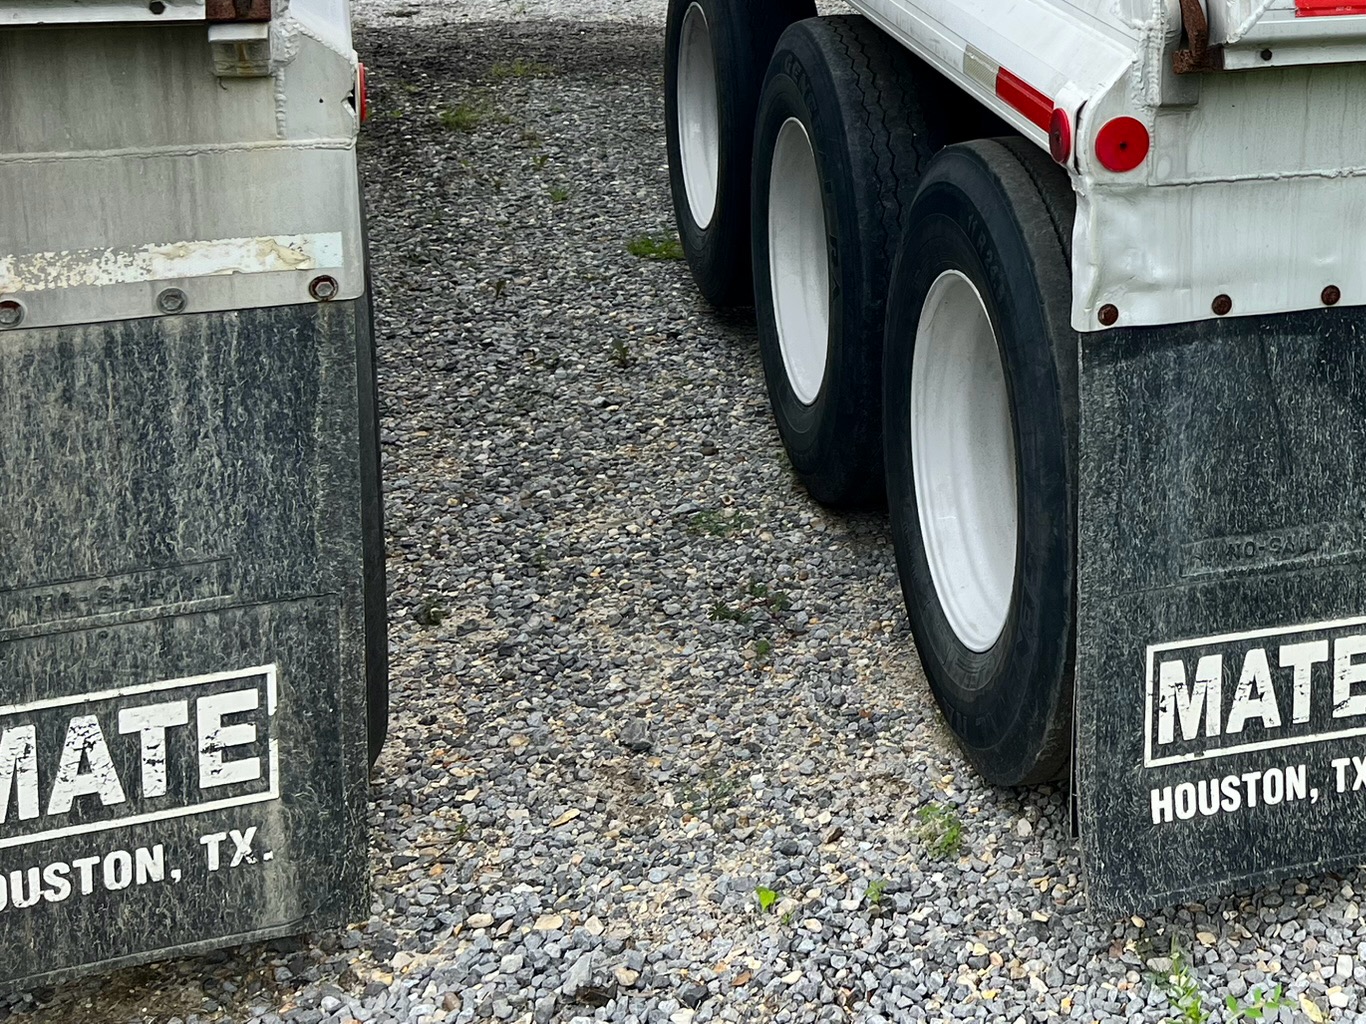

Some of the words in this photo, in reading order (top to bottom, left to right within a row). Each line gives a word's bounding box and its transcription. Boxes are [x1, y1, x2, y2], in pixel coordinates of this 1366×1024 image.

[1150, 764, 1320, 825] HOUSTON,
[0, 842, 182, 912] USTON,
[199, 825, 274, 868] TX.
